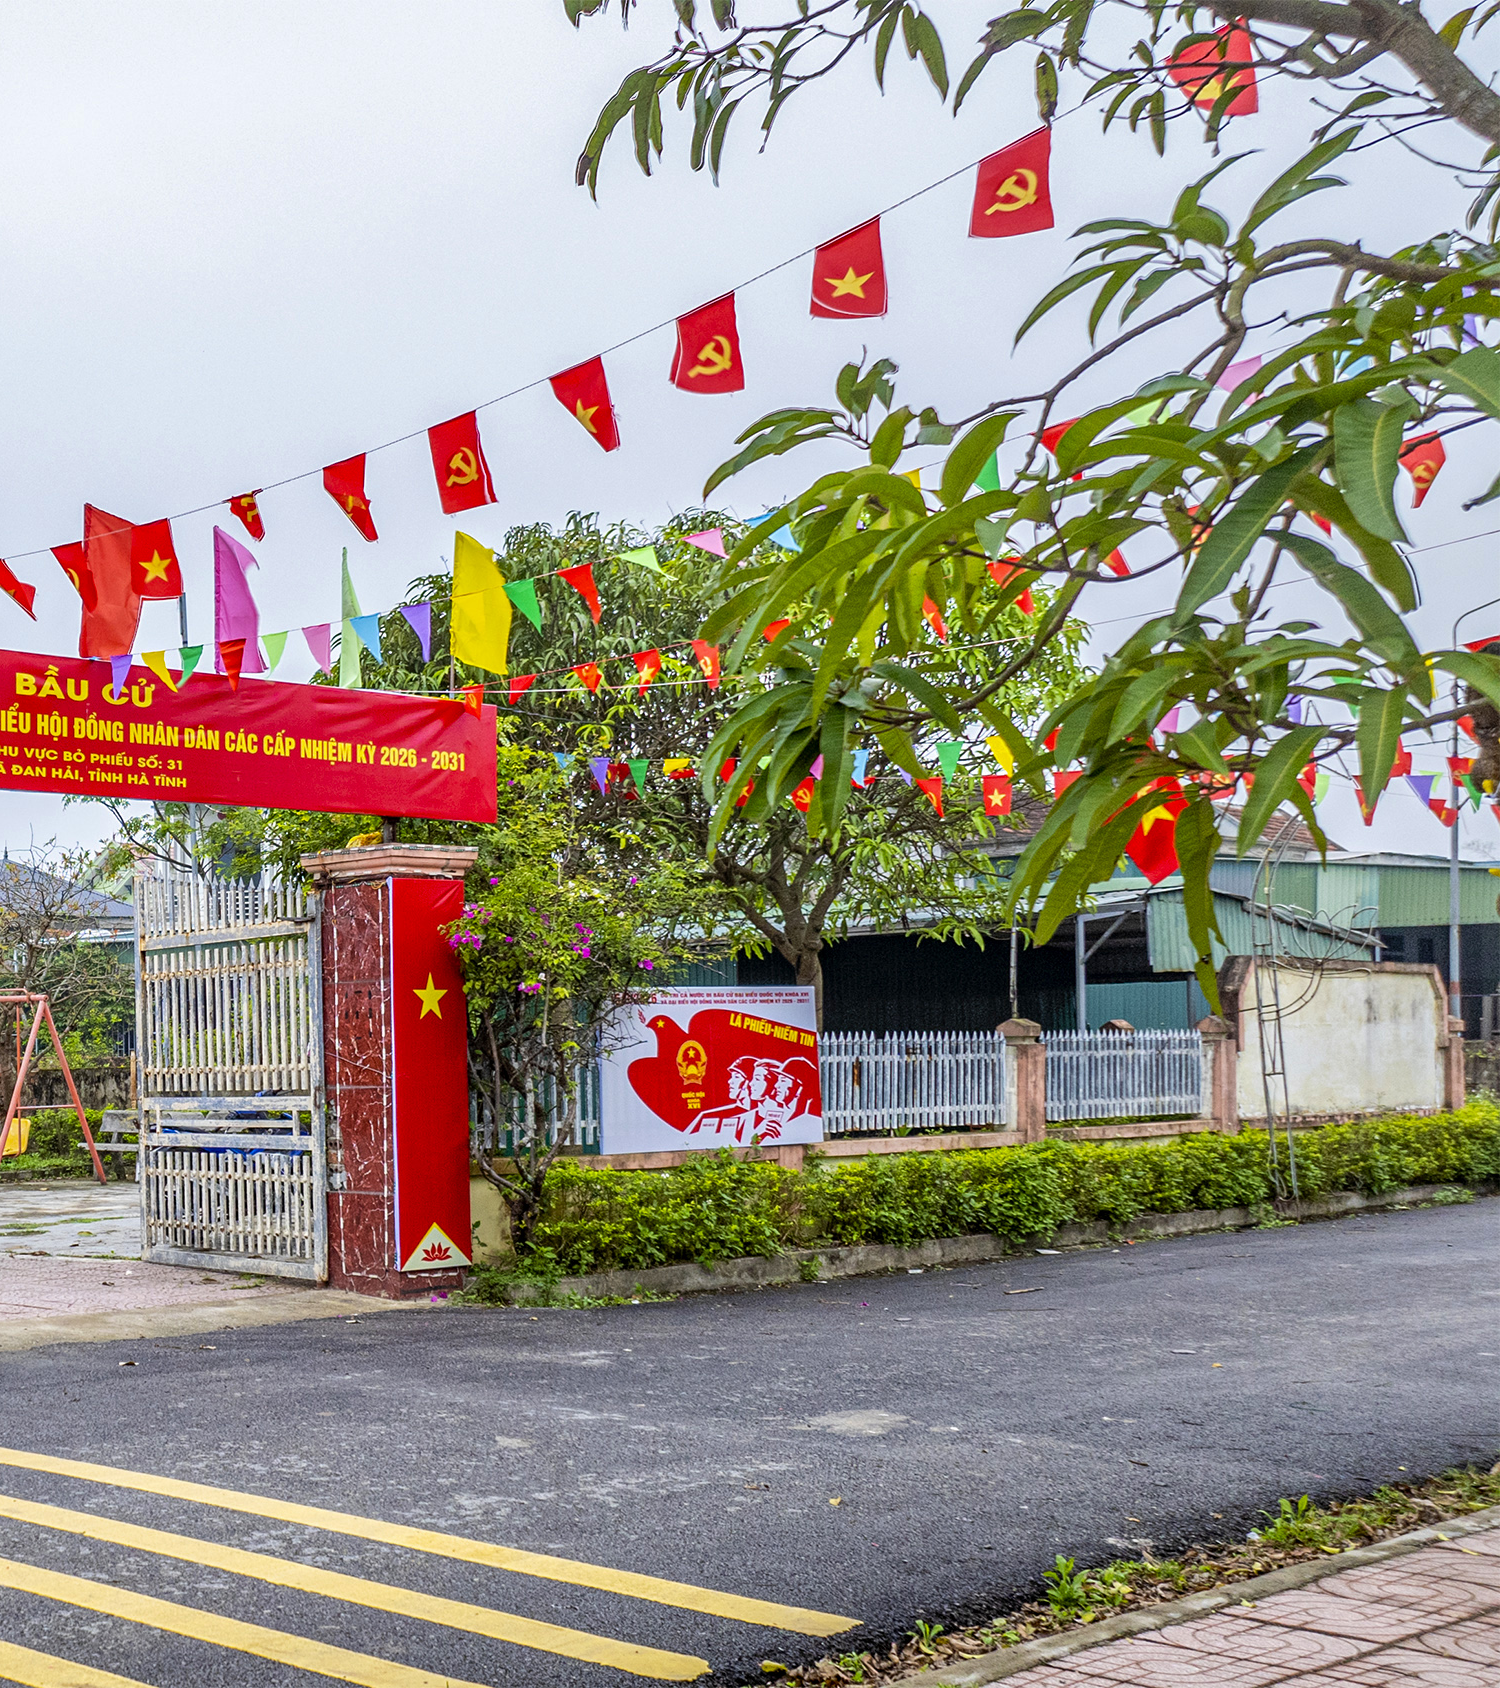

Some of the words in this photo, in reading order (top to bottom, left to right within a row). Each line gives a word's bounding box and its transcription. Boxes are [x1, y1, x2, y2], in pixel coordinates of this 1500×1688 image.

[16, 664, 88, 701] BẦU
[102, 678, 155, 707] CỬ
[37, 711, 68, 741] HỘI
[74, 712, 124, 742] ĐỒNG
[129, 721, 179, 747] NHÂN
[184, 724, 220, 750] DÂN
[224, 728, 258, 754] CÁC
[263, 730, 296, 757] CẤP
[300, 737, 352, 765] NHIỆM
[356, 741, 376, 764] KỲ
[380, 746, 417, 768] 2026
[431, 750, 465, 771] 2031
[23, 747, 58, 762] VỰC
[63, 748, 86, 763] BỎ
[90, 752, 133, 767] PHIẾU
[137, 754, 163, 770] SỐ:
[167, 760, 183, 770] 31
[11, 764, 47, 777] ĐAN
[51, 765, 84, 782] HẢI,
[88, 769, 123, 784] TỈNH
[127, 772, 149, 786] HÀ
[153, 774, 187, 788] TĨNH
[729, 1013, 742, 1028] LÁ
[800, 1032, 815, 1047] TIN
